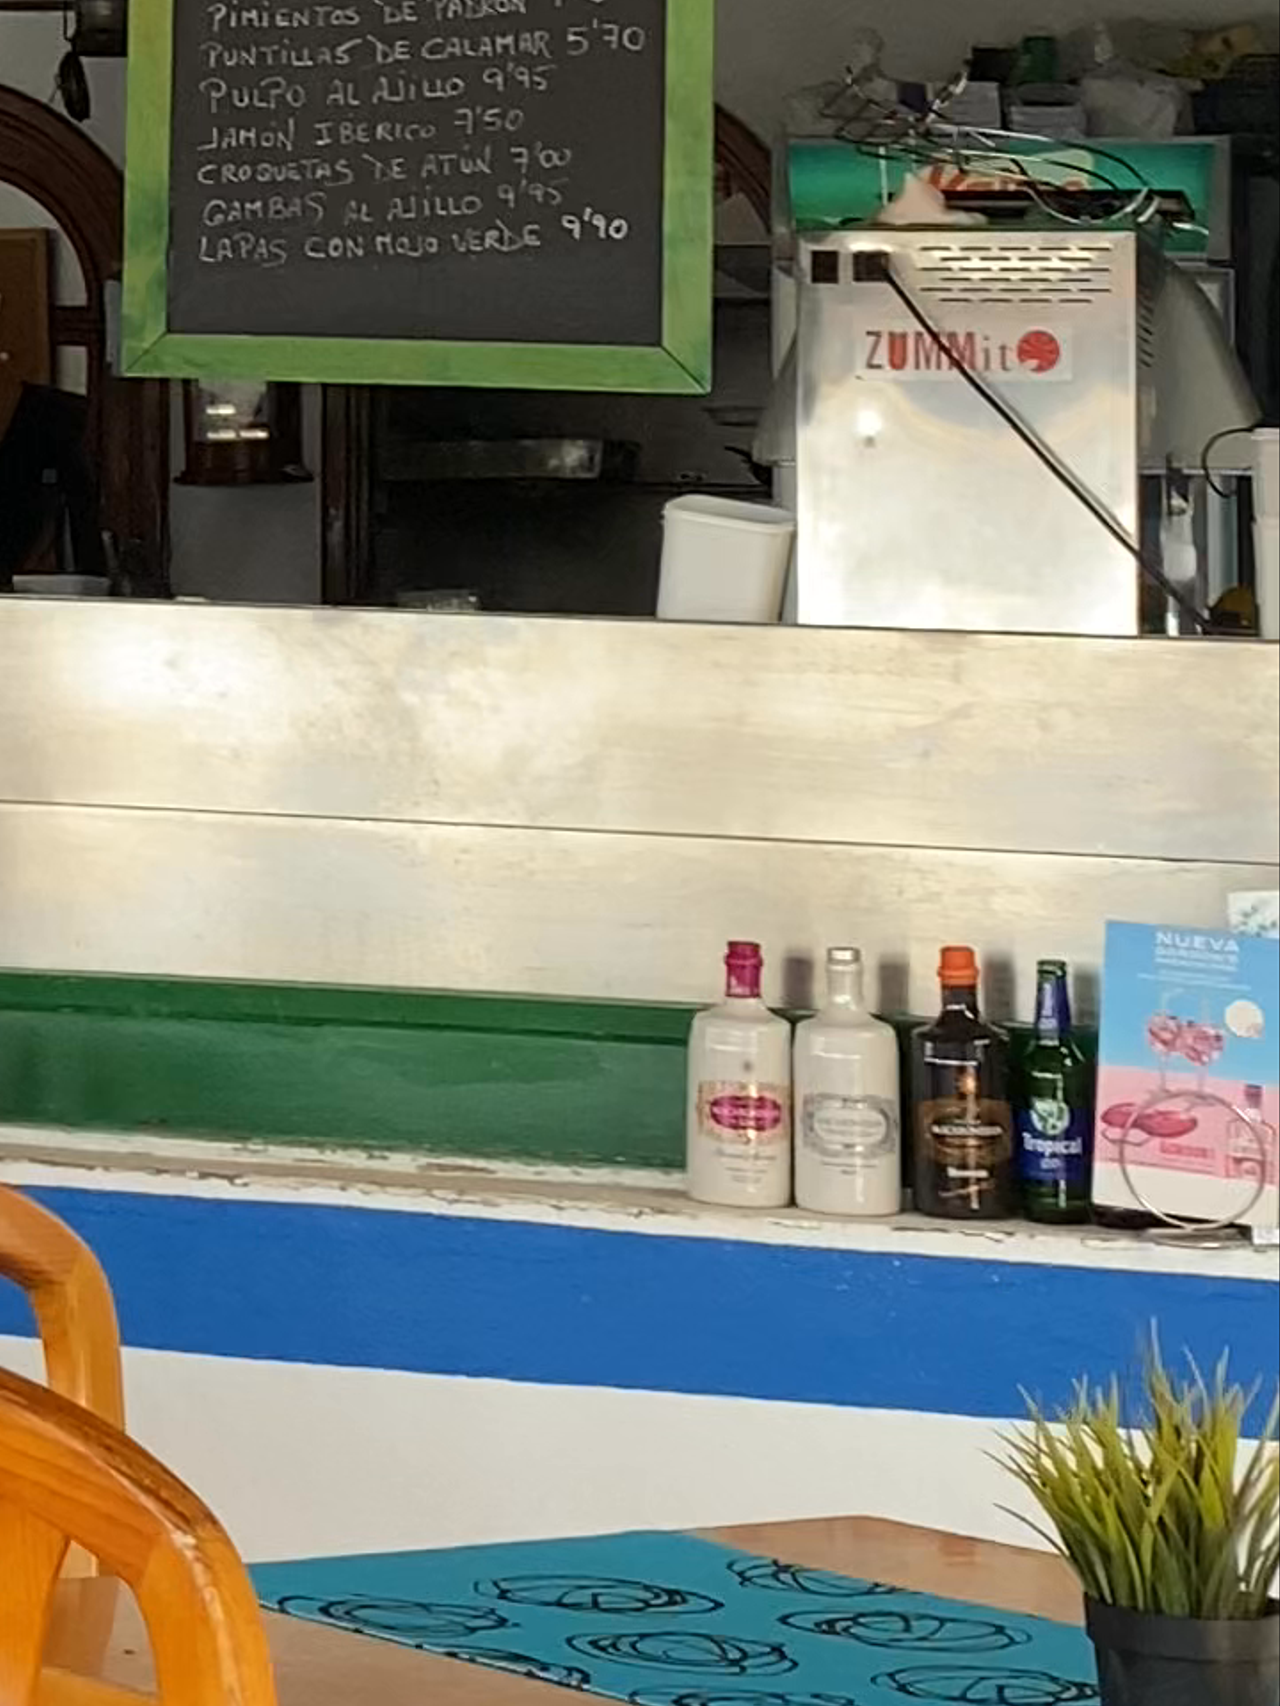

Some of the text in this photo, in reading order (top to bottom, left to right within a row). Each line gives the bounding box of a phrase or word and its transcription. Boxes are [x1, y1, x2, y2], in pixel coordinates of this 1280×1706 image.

[206, 0, 360, 32] PIMIENTOS
[200, 38, 363, 68] PUNTILLAS
[367, 34, 411, 64] DE
[421, 31, 552, 59] CALAMAR
[198, 76, 306, 113] PULPO
[326, 79, 361, 106] AL
[197, 158, 354, 186] CROQUETAS
[362, 153, 407, 181] DE
[203, 192, 326, 226] GAMBAS
[344, 199, 374, 225] AL
[387, 191, 483, 221] AJILLO
[199, 233, 288, 268] LAPAS
[304, 237, 364, 258] CON
[374, 234, 439, 257] MOJO
[452, 219, 541, 252] VERDE
[1155, 931, 1239, 952] NUEVA
[1022, 1132, 1082, 1157] Tropical
